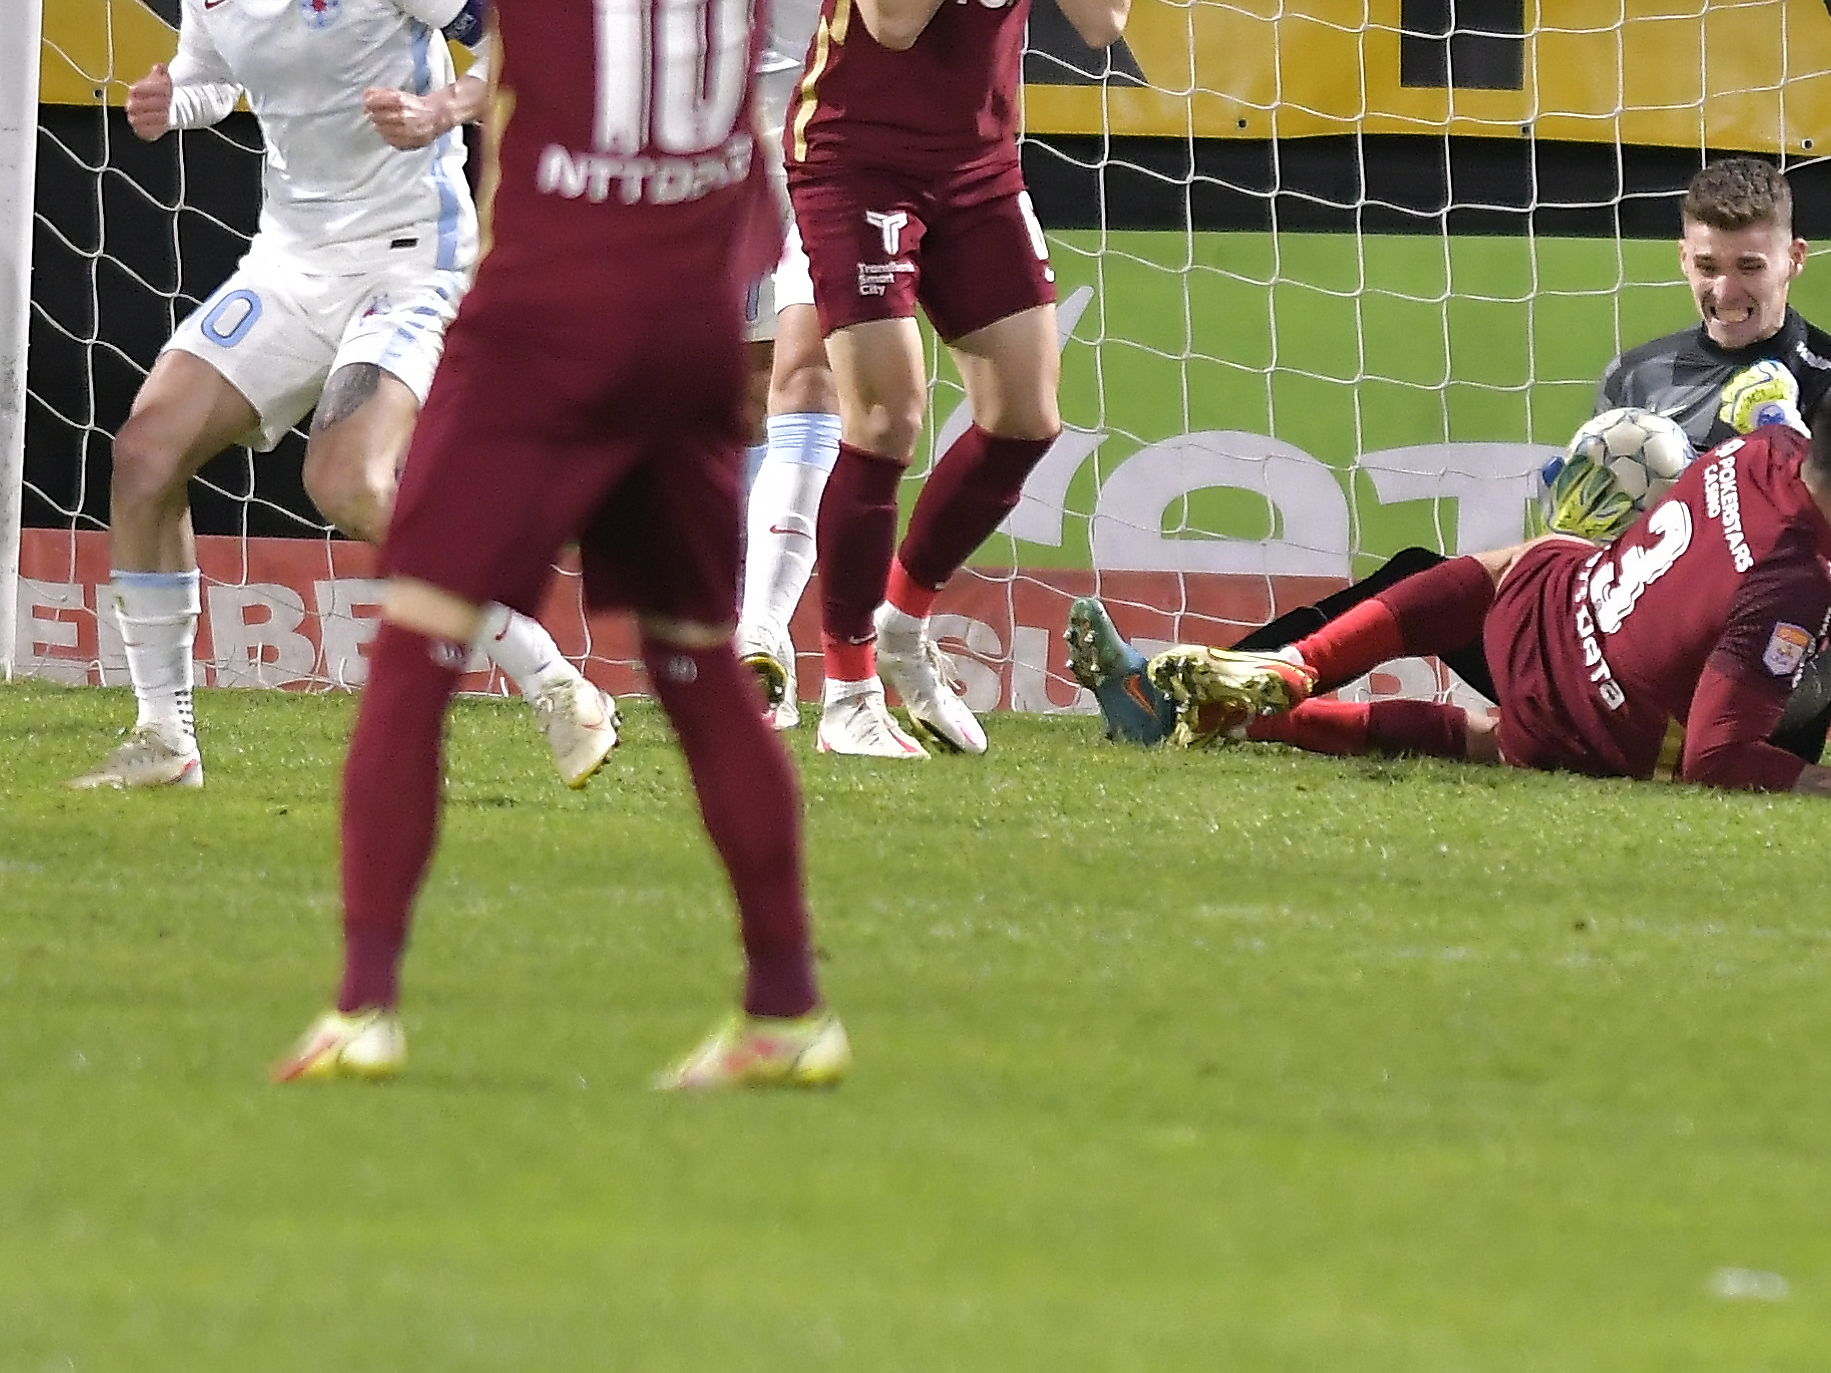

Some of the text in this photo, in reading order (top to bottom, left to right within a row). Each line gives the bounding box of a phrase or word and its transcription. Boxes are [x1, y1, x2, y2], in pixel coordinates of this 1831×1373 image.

[185, 281, 262, 348] 0
[1590, 500, 1692, 634] 3
[1716, 456, 1755, 574] POKERSTARS
